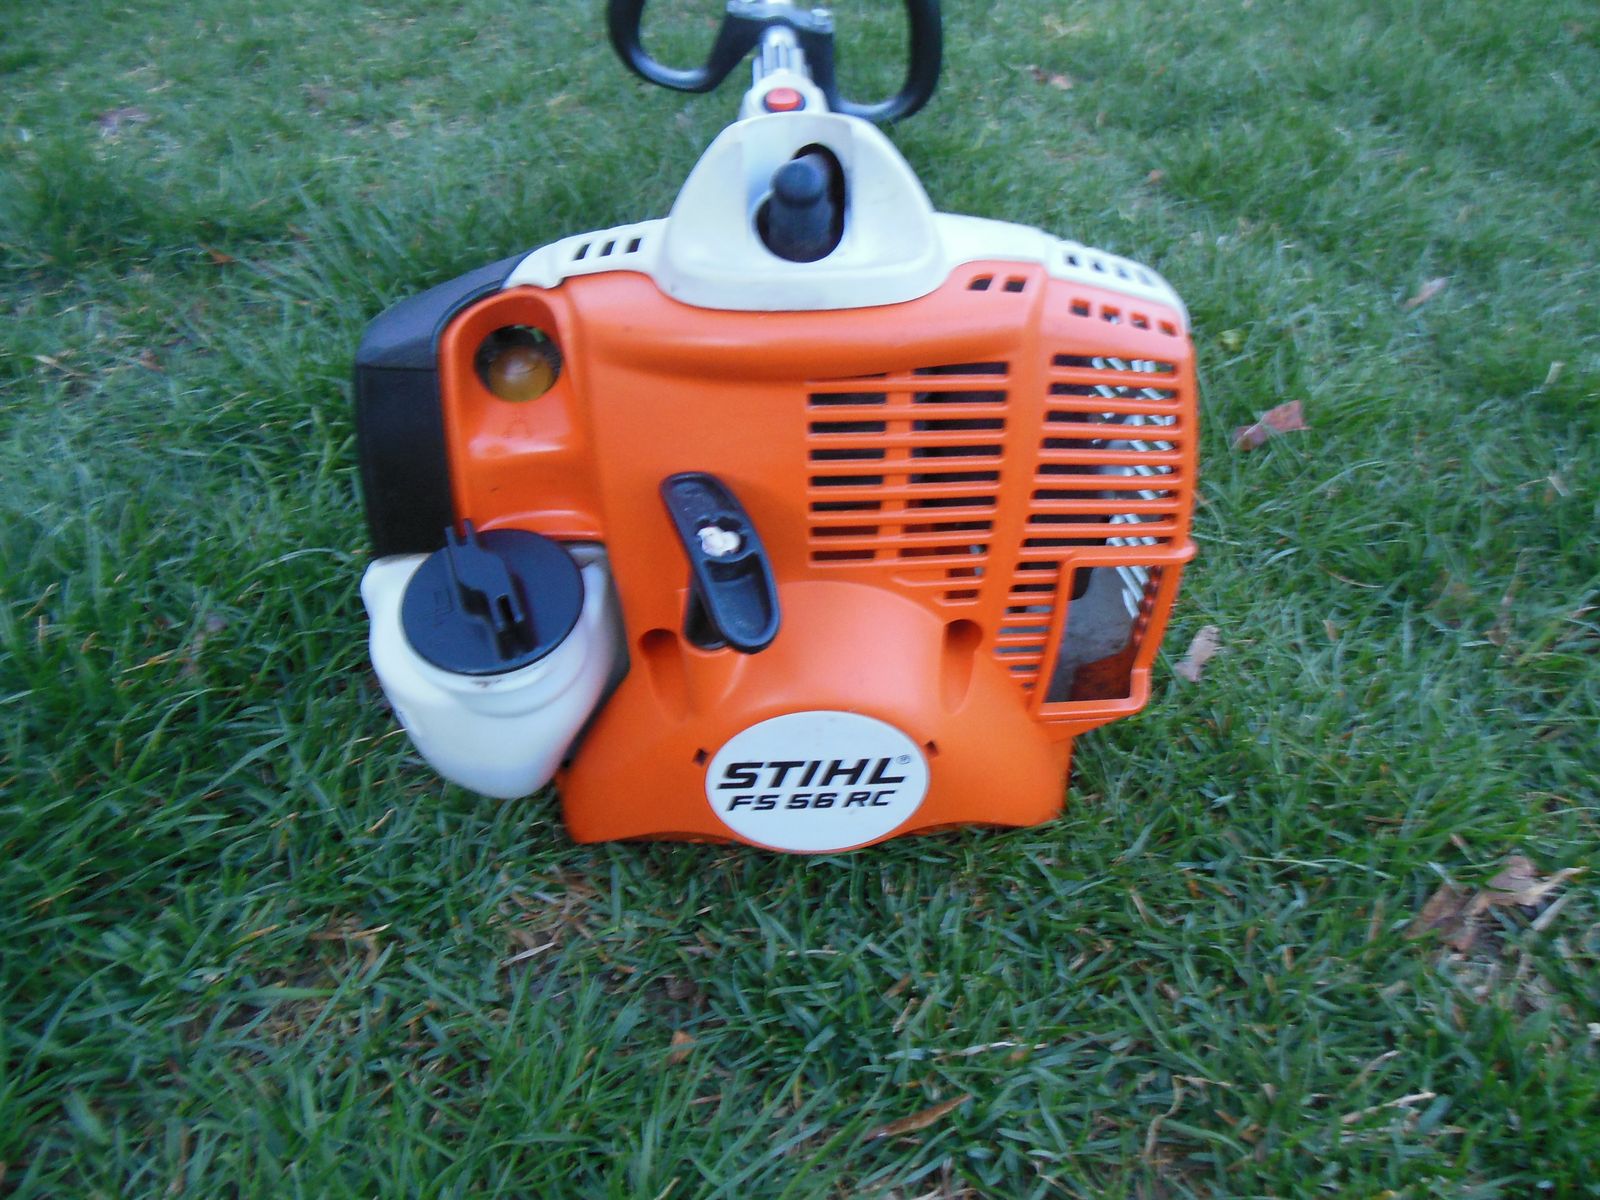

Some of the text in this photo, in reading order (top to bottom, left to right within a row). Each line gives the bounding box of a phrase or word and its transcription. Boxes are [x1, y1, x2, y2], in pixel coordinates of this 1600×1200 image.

[726, 790, 897, 811] FS 56 RC
